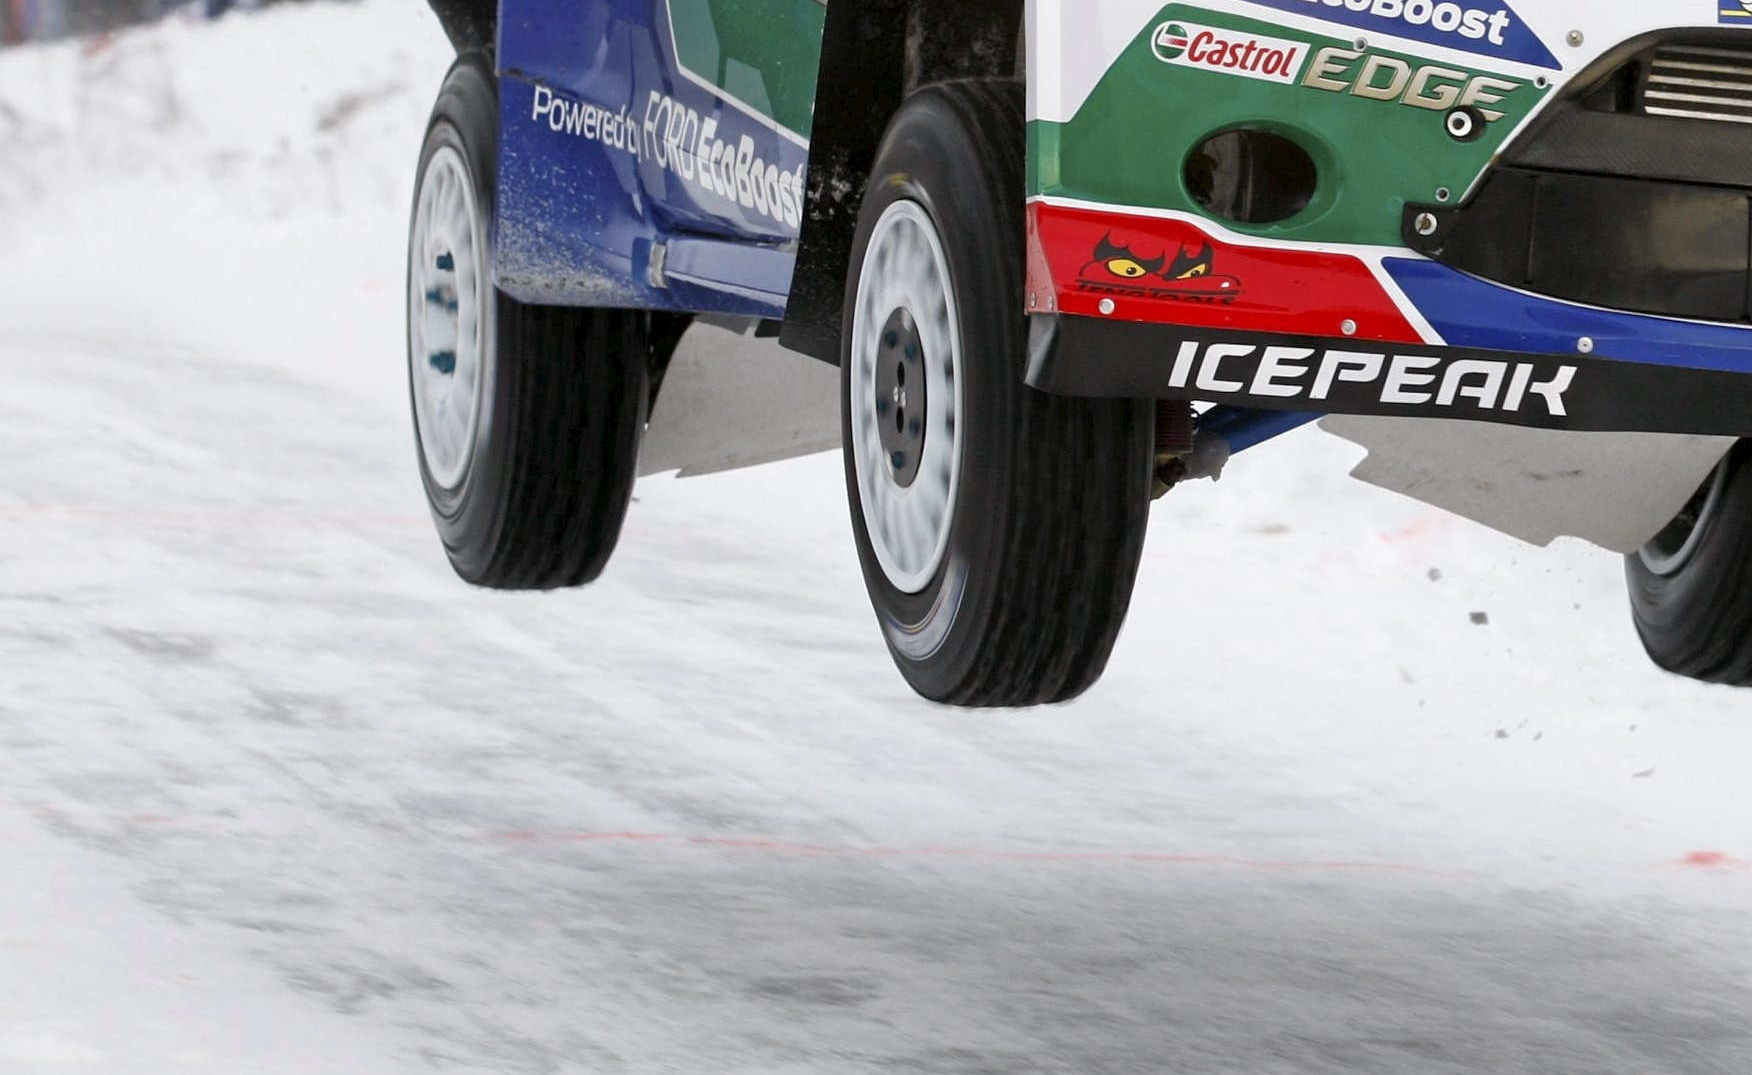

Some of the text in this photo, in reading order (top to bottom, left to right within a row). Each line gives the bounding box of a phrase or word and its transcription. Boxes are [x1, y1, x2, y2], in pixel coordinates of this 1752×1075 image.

[1184, 30, 1523, 124] Castrol EDGE
[532, 85, 626, 150] Powered
[643, 89, 698, 181] FORD
[699, 116, 805, 229] EcoBoost
[1167, 340, 1578, 417] ICEPEAK
